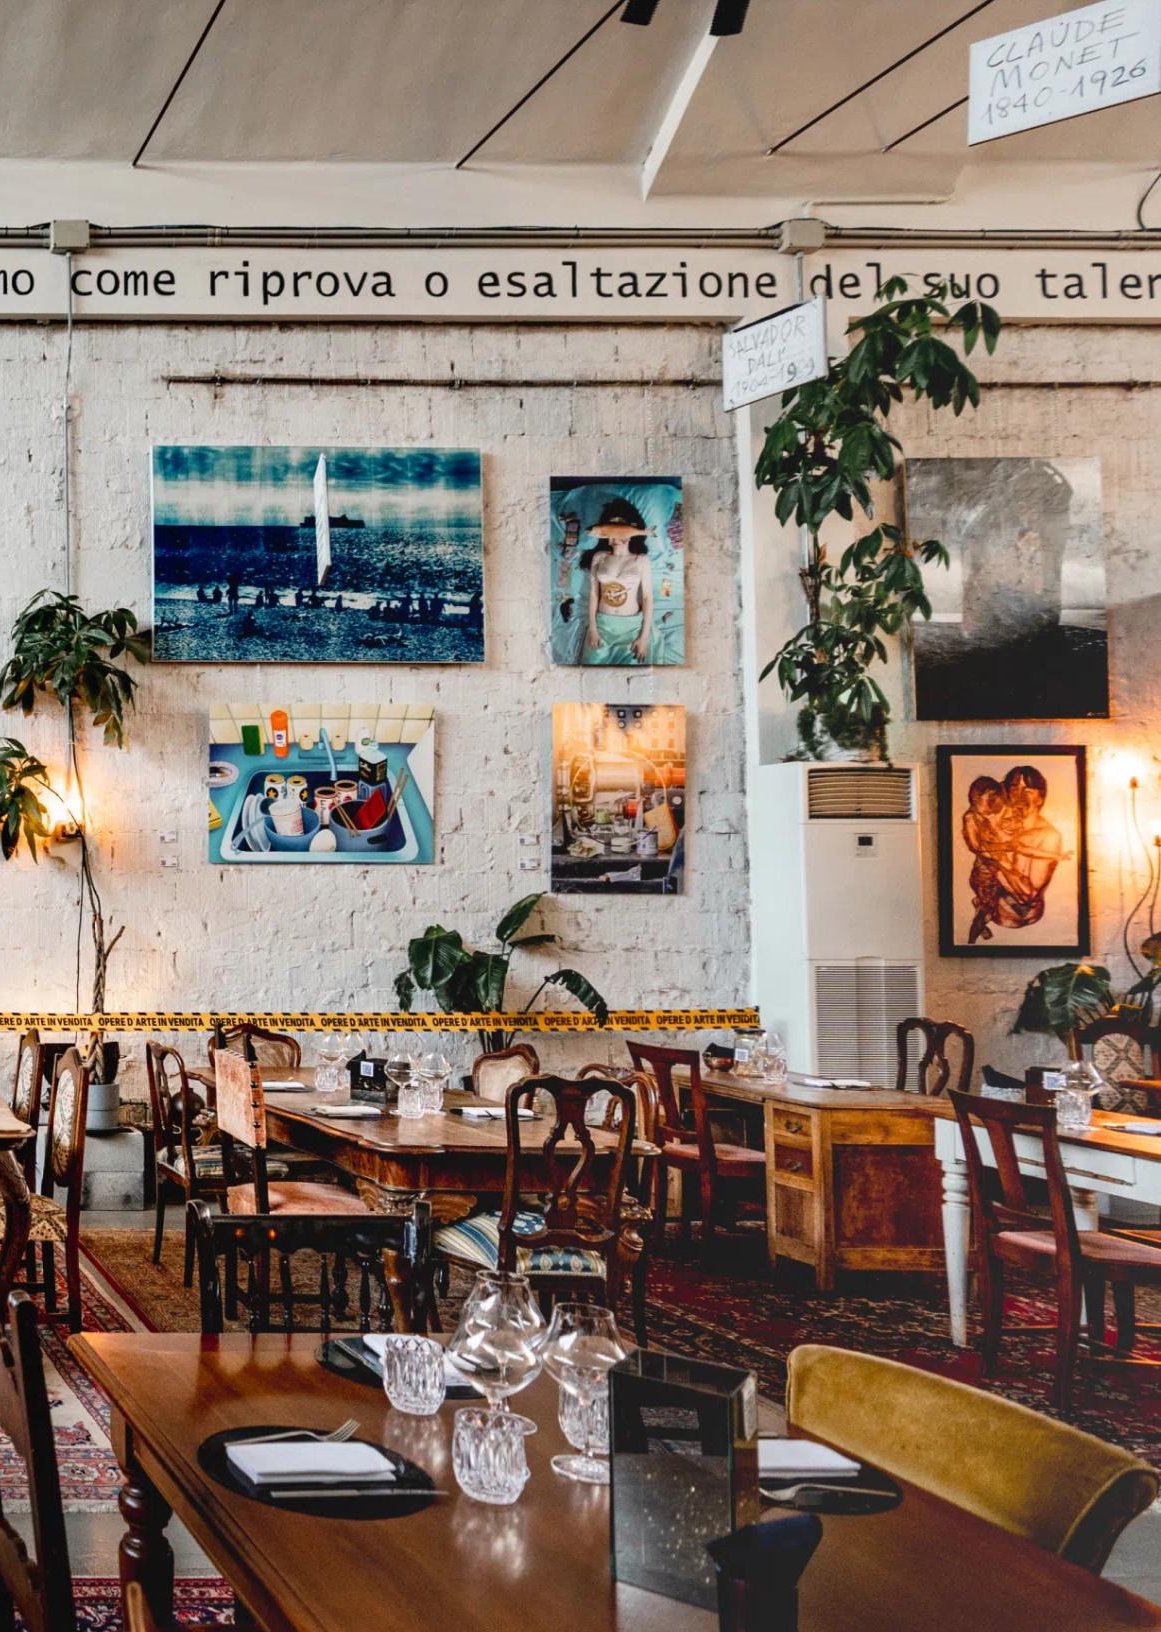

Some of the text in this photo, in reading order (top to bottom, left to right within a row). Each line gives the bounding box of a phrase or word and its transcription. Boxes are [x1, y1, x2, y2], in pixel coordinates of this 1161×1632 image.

[986, 8, 1128, 68] CLAUDE
[981, 59, 1147, 124] 1840-1926
[988, 33, 1140, 98] MONET
[70, 268, 175, 296] come
[209, 259, 394, 305] riprova
[425, 269, 449, 299] o
[478, 261, 778, 299] esaltazione
[810, 262, 883, 300] del
[923, 269, 1000, 300] suo
[729, 315, 806, 359] SALVADOR
[48, 1017, 56, 1026] IN
[58, 1018, 93, 1026] VENDITA
[98, 1017, 125, 1026] OPERE
[158, 1018, 167, 1026] IN
[168, 1018, 204, 1026] VENDITA
[270, 1018, 278, 1027] IN
[280, 1018, 315, 1027] VENDITA
[321, 1018, 348, 1027] OPERE
[381, 1018, 389, 1027] IN
[391, 1018, 427, 1027] VENDITA
[433, 1018, 460, 1027] OPERE
[493, 1018, 501, 1026] IN
[503, 1017, 539, 1026] VENDITA
[544, 1016, 571, 1026] OPERE
[614, 1016, 650, 1025] VENDITA
[657, 1015, 684, 1025] OPERE
[717, 1015, 725, 1024] IN
